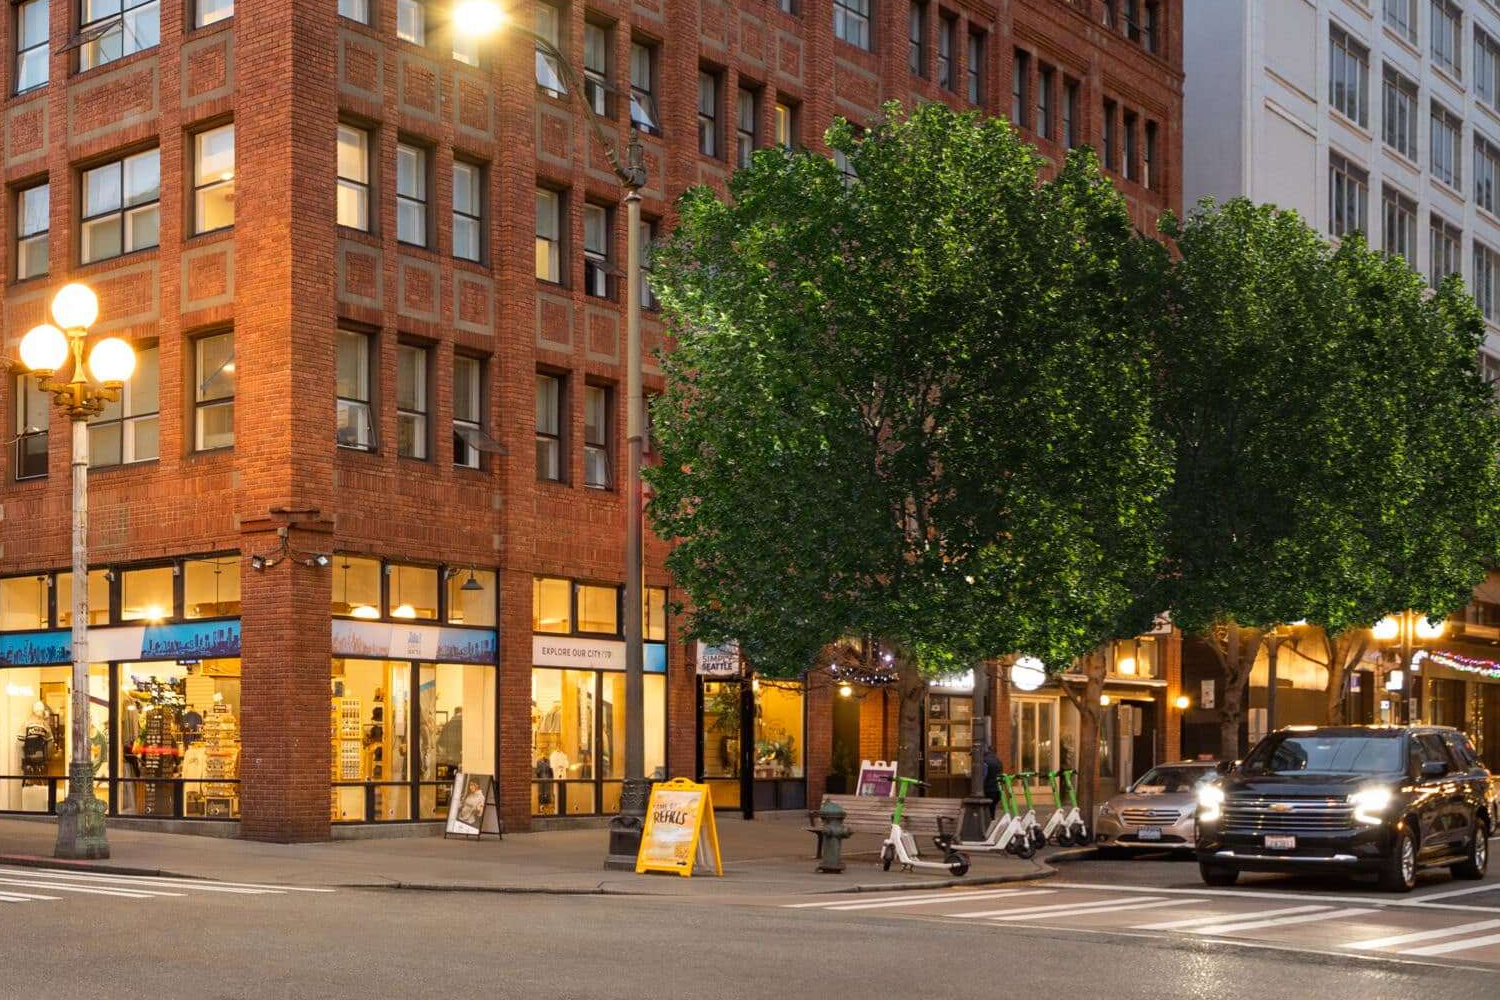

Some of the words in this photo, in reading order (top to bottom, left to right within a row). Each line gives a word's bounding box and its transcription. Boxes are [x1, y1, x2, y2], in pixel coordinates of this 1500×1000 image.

[542, 647, 571, 657] EXPLORE
[572, 648, 586, 657] OUR
[702, 663, 732, 671] SEATTLE
[654, 809, 688, 825] REFILLS
